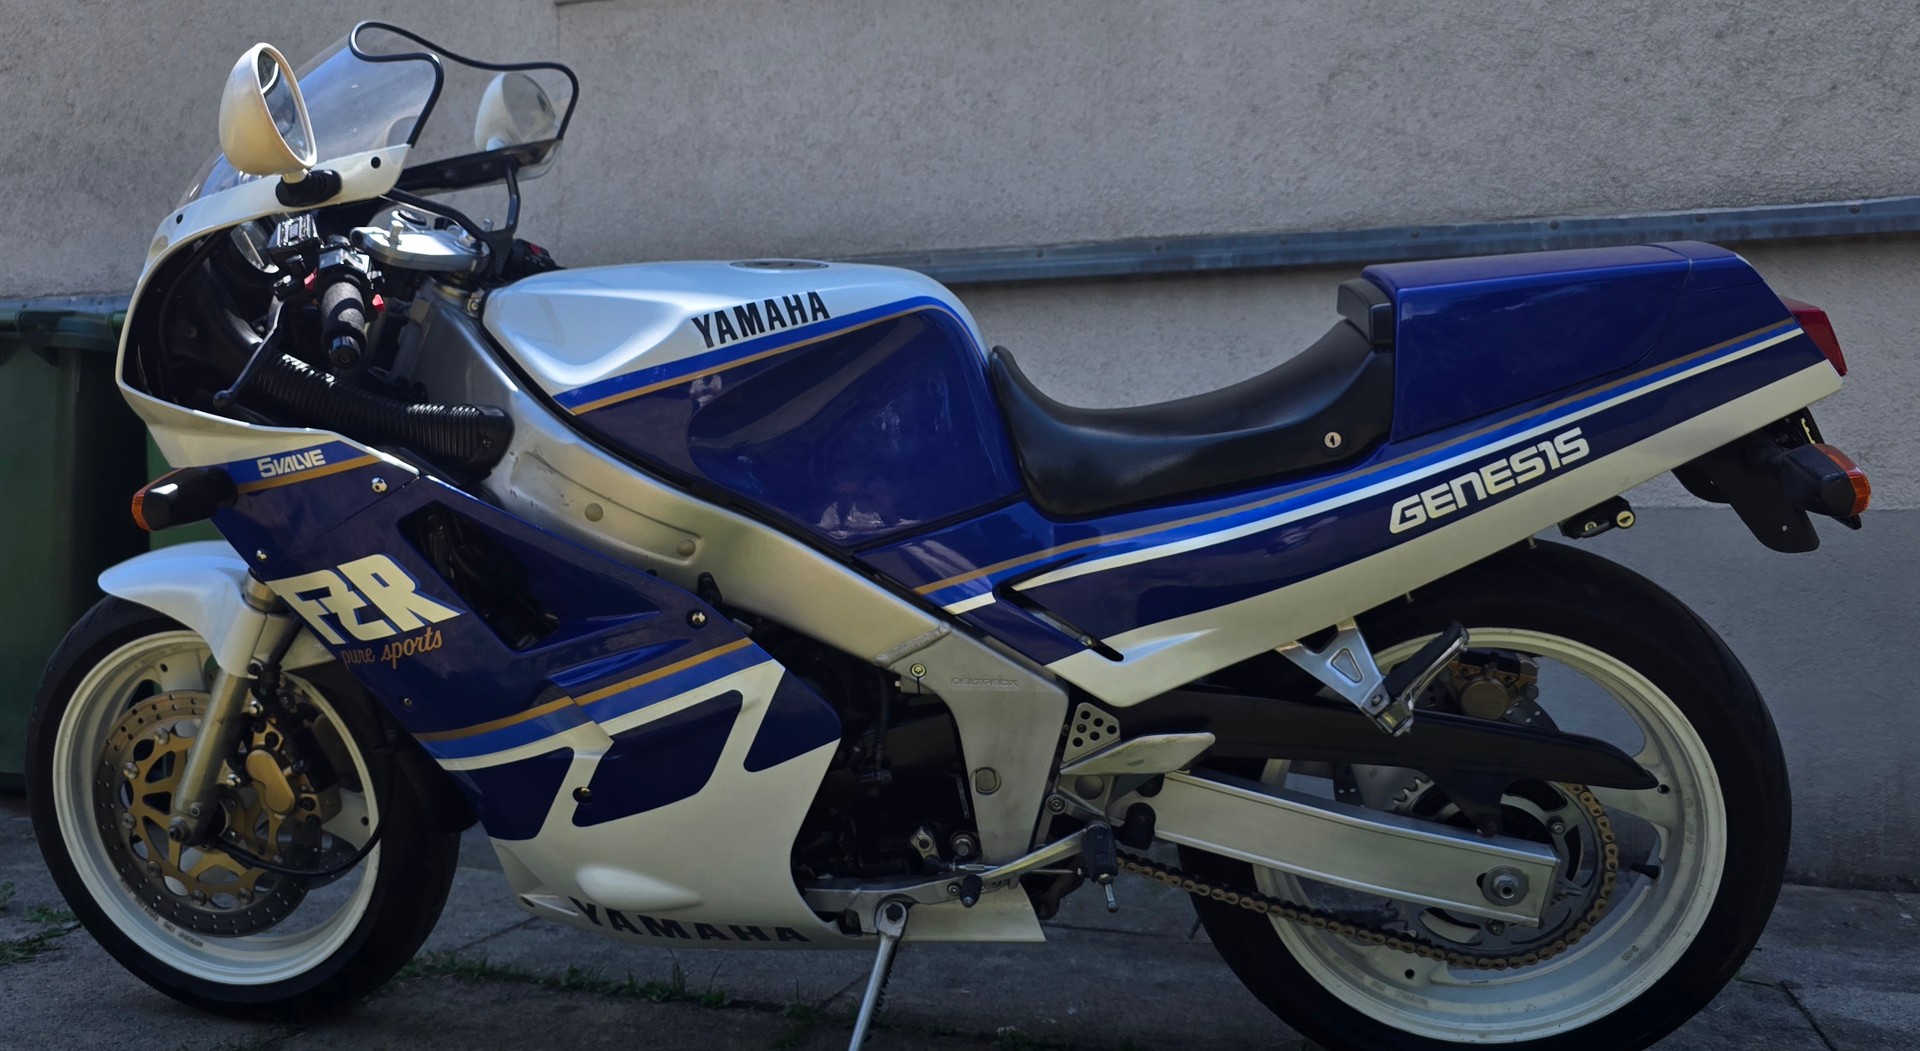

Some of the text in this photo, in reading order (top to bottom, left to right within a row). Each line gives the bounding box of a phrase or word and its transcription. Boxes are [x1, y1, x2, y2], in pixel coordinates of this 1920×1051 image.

[691, 291, 830, 348] YAMAHA
[1389, 427, 1590, 534] GENESIS
[265, 553, 464, 645] FZR
[341, 627, 443, 670] pure sports
[950, 677, 1019, 689] DELTABOX
[568, 896, 811, 942] YAMAHA
